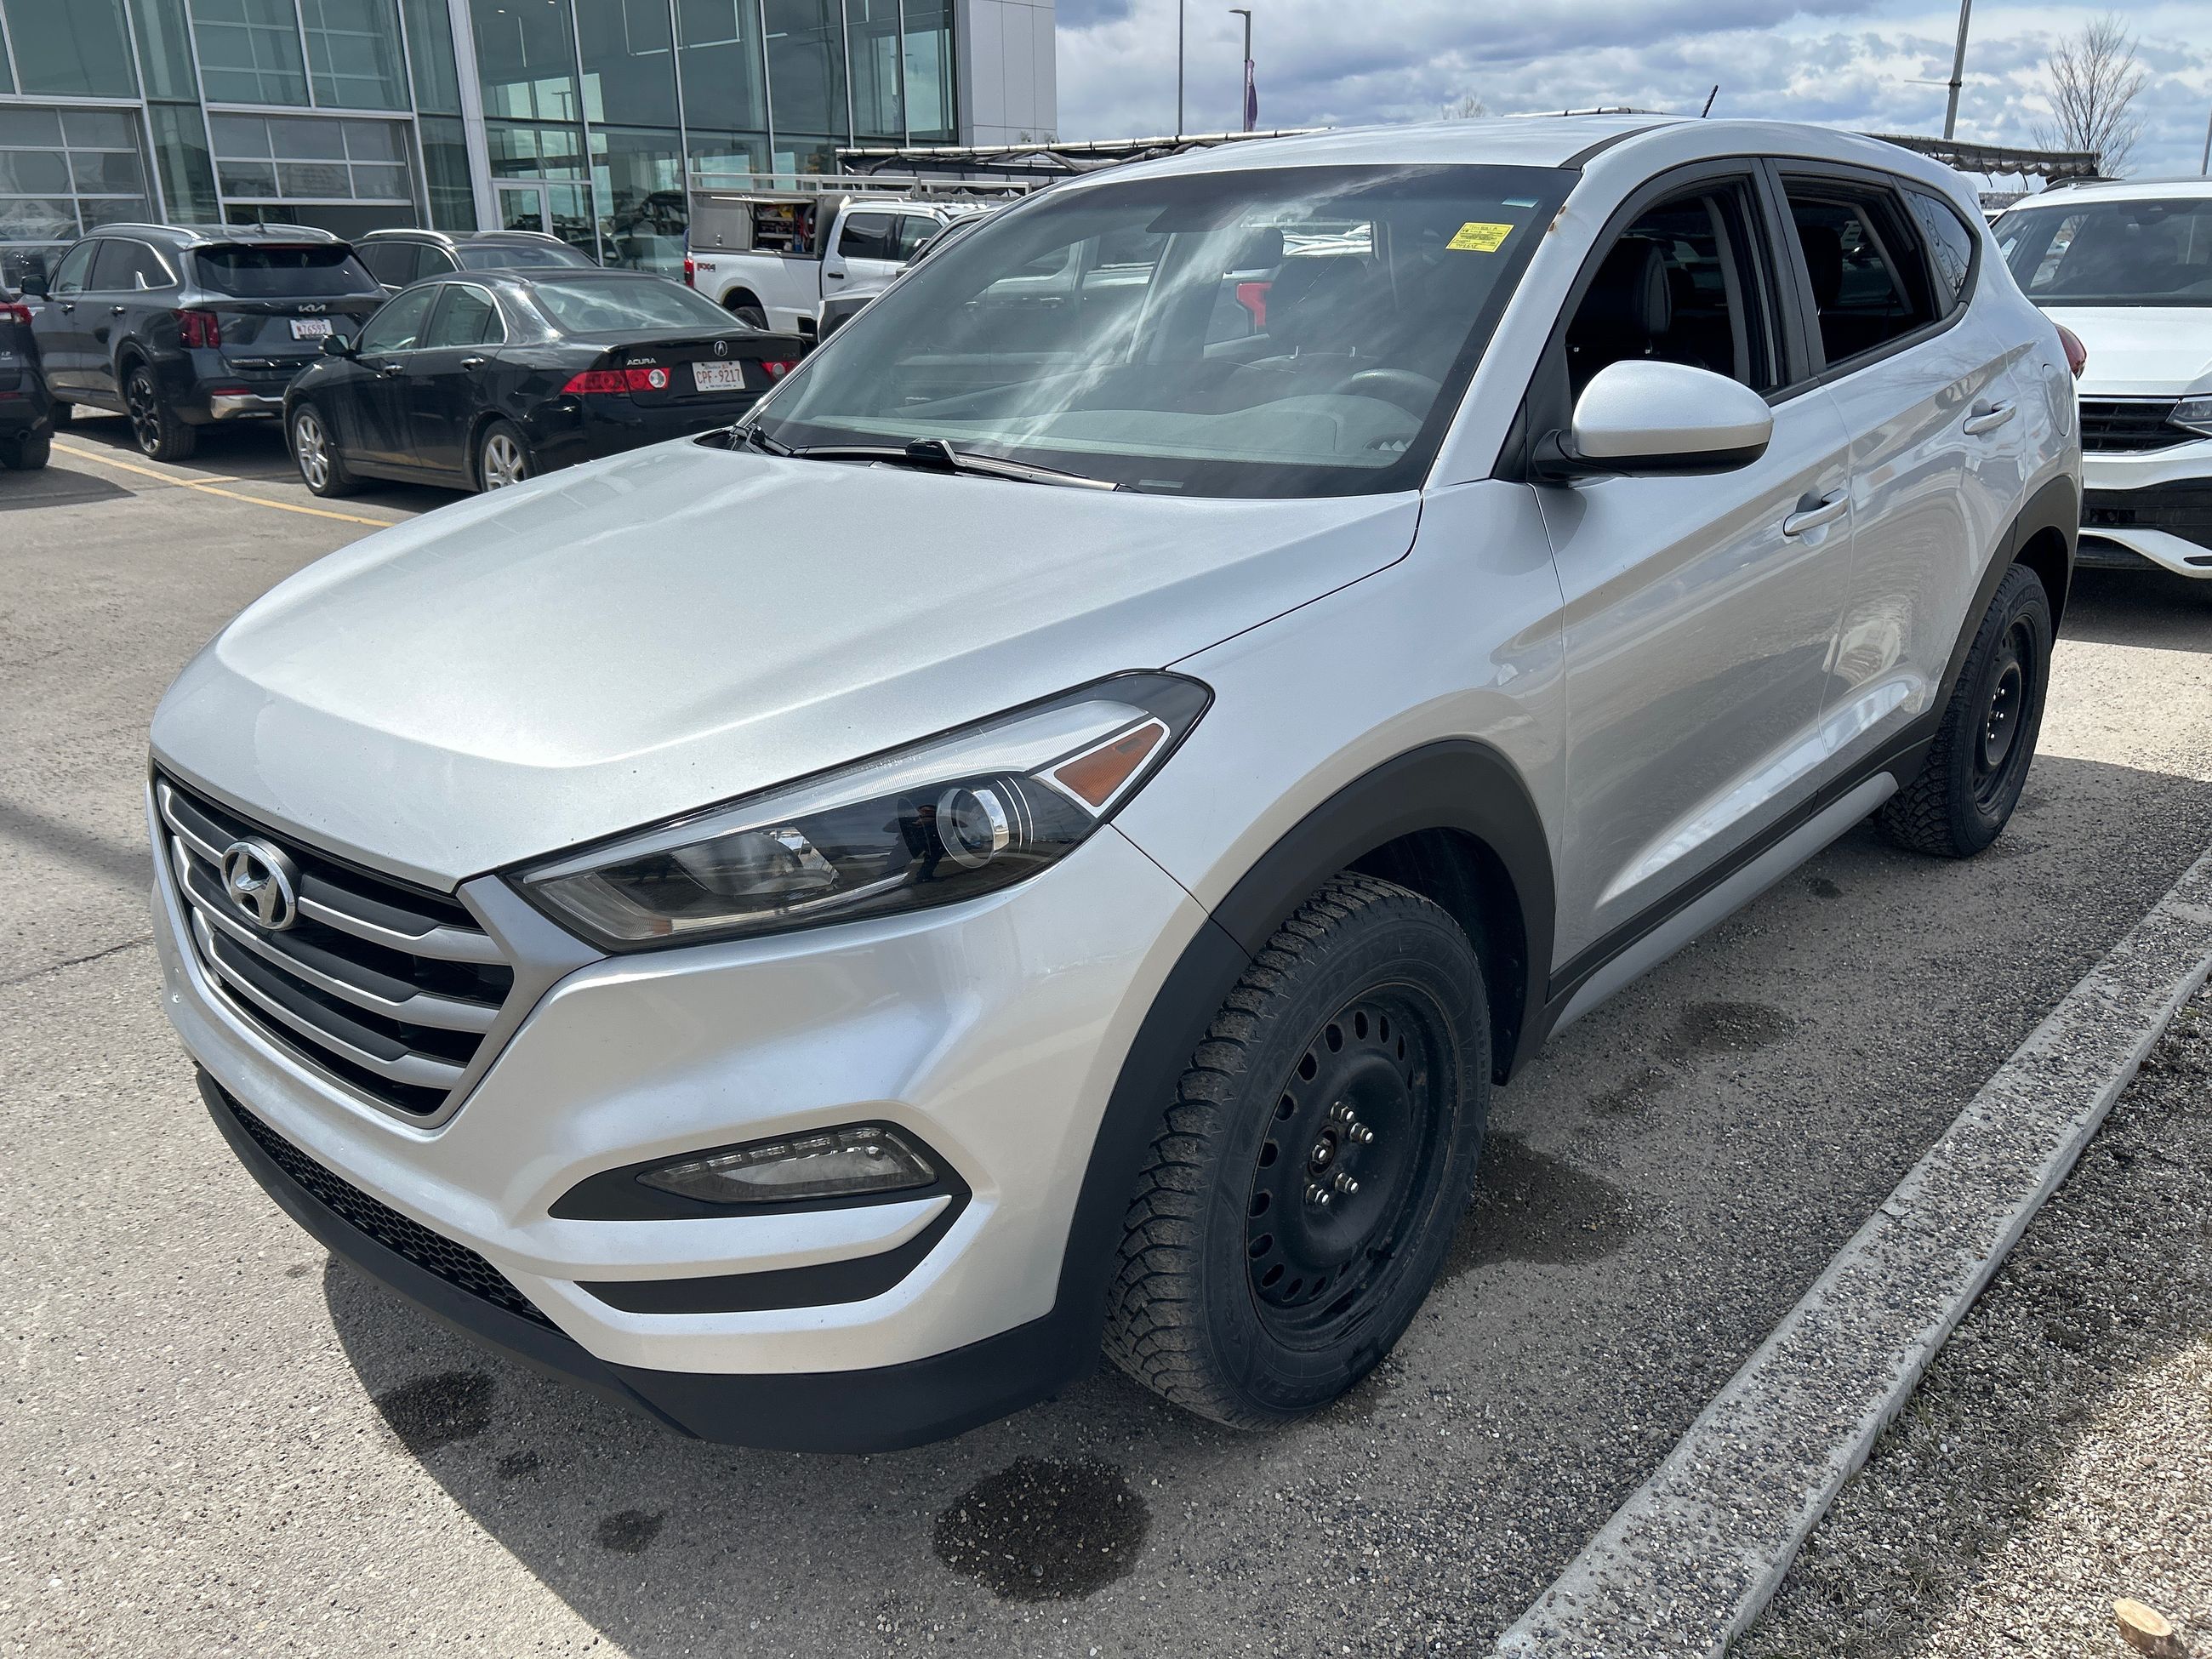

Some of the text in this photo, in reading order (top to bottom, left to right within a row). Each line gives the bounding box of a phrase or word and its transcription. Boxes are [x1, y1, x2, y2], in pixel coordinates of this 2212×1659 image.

[697, 262, 716, 272] FX4
[298, 304, 327, 312] KIA
[626, 357, 657, 366] ACURA
[696, 368, 740, 384] CPF-9217
